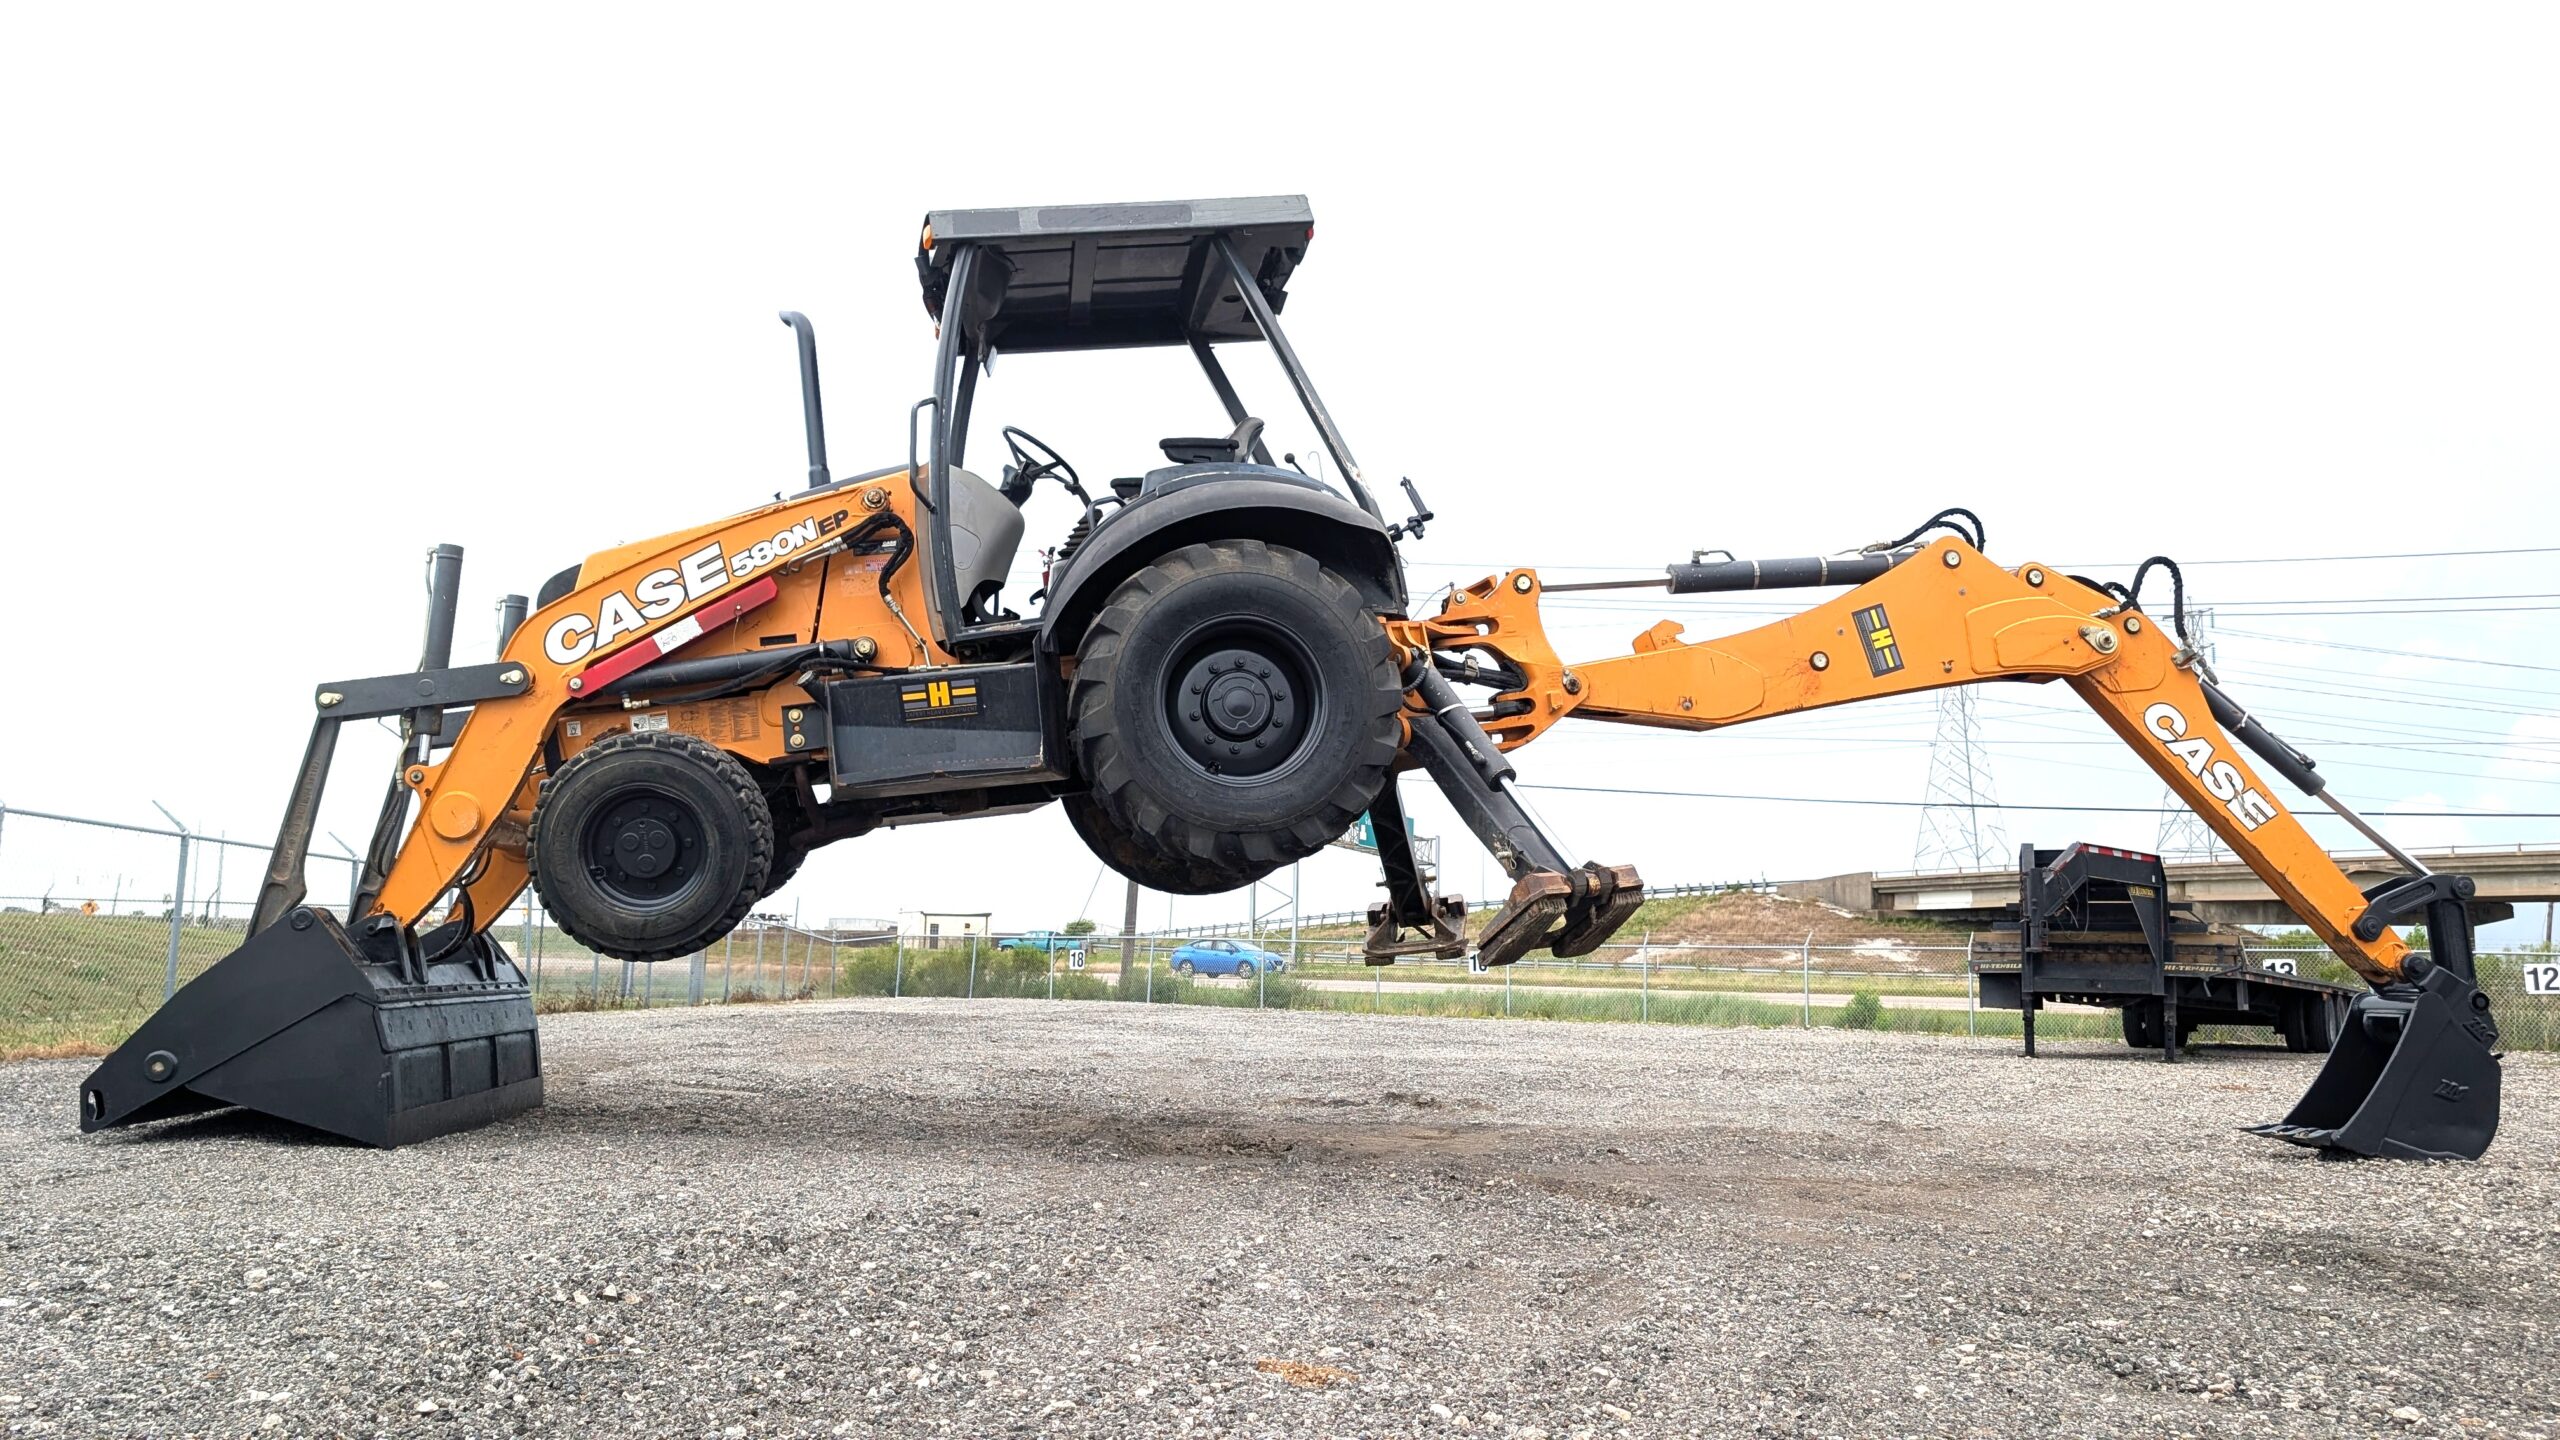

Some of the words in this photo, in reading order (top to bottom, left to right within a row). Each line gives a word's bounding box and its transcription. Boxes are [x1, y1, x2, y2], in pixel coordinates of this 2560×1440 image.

[544, 541, 729, 665] CASE
[928, 681, 951, 707] H
[2144, 702, 2279, 832] CASE
[1071, 951, 1084, 968] 18
[2526, 967, 2560, 991] 12
